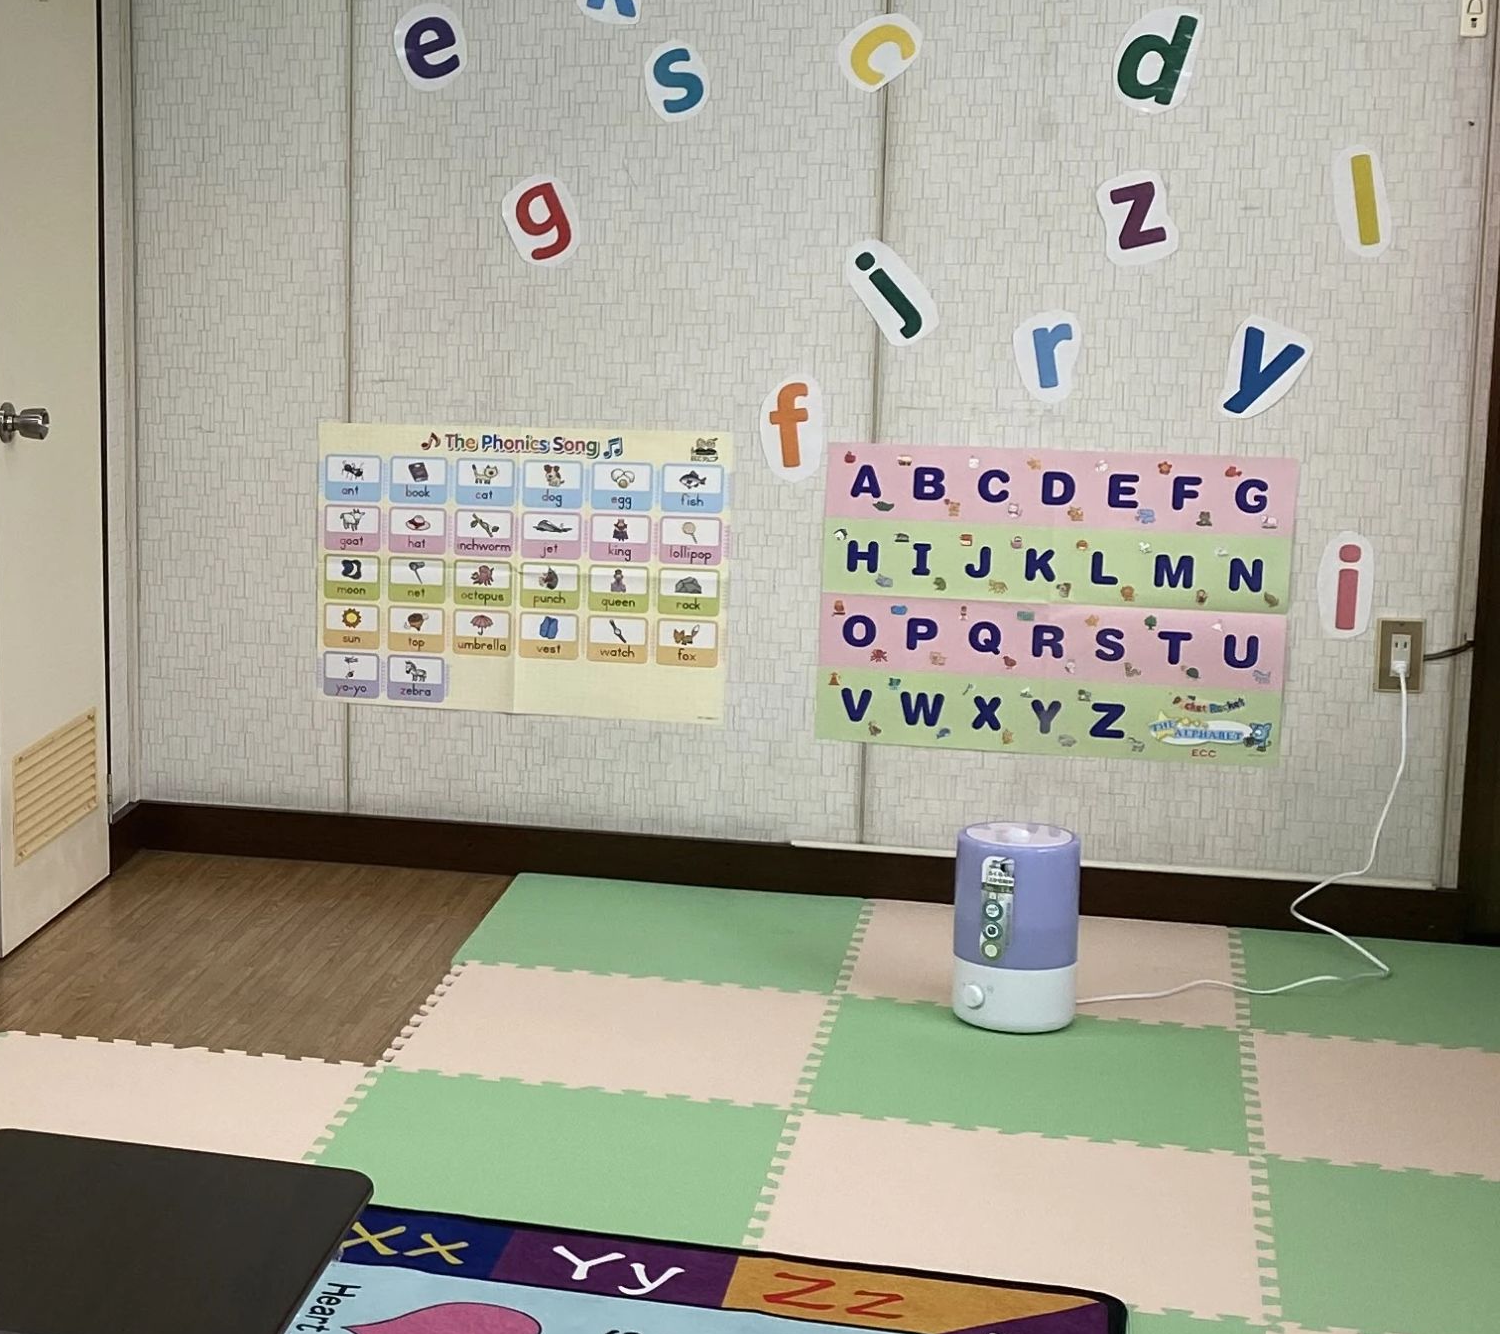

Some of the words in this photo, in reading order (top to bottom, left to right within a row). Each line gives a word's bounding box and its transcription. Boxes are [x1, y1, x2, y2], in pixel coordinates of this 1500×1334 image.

[405, 17, 459, 78] e
[849, 23, 916, 86] c
[1118, 16, 1197, 105] d
[653, 48, 704, 113] s
[516, 183, 572, 260] g
[856, 253, 921, 338] j
[1033, 323, 1072, 388] r
[1224, 326, 1305, 413] y
[768, 382, 809, 469] f
[445, 434, 478, 451] The
[482, 434, 550, 453] Phonics
[553, 436, 600, 459] Song
[341, 487, 359, 496] ant
[405, 486, 430, 498] book
[475, 490, 493, 500] cat
[851, 464, 881, 498] A
[913, 466, 945, 501] B
[978, 469, 1009, 504] C
[1041, 470, 1076, 507] D
[1107, 473, 1137, 509] E
[1172, 475, 1201, 510] F
[1234, 478, 1269, 514] G
[542, 489, 562, 507] dog
[611, 495, 632, 510] egg
[680, 493, 704, 507] fish
[340, 537, 363, 550] goat
[407, 538, 426, 549] hat
[539, 544, 558, 558] jet
[608, 544, 631, 562] king
[669, 545, 712, 564] lollipop
[847, 541, 879, 572] H
[912, 541, 932, 577] I
[966, 548, 991, 578] J
[1025, 549, 1054, 581] K
[1091, 553, 1116, 585] L
[1154, 554, 1194, 588] M
[1229, 558, 1263, 592] N
[337, 586, 366, 596] moon
[407, 588, 425, 598] net
[1336, 544, 1361, 631] i
[460, 589, 505, 606] octopus
[533, 590, 566, 608] punch
[601, 597, 636, 612] queen
[675, 598, 700, 611] rock
[342, 635, 361, 644] sun
[408, 637, 425, 652] top
[457, 637, 507, 651] umbrella
[842, 614, 877, 648] O
[906, 617, 938, 649] P
[968, 622, 1002, 653] Q
[1032, 624, 1064, 657] R
[1097, 629, 1125, 661] S
[1160, 630, 1190, 664] T
[1223, 634, 1260, 669] U
[536, 643, 561, 654] vest
[600, 645, 635, 658] watch
[677, 648, 697, 661] fox
[336, 684, 367, 697] yo-yo
[400, 684, 431, 697] zebra
[841, 689, 871, 721] V
[901, 692, 943, 727] W
[973, 697, 1000, 729] X
[1031, 699, 1062, 734] Y
[1090, 702, 1124, 739] Z
[1174, 728, 1244, 741] ALPHABET
[1191, 748, 1217, 758] ECC
[344, 1221, 469, 1265] Xx
[553, 1246, 686, 1296] Yy
[298, 1282, 362, 1334] Heart
